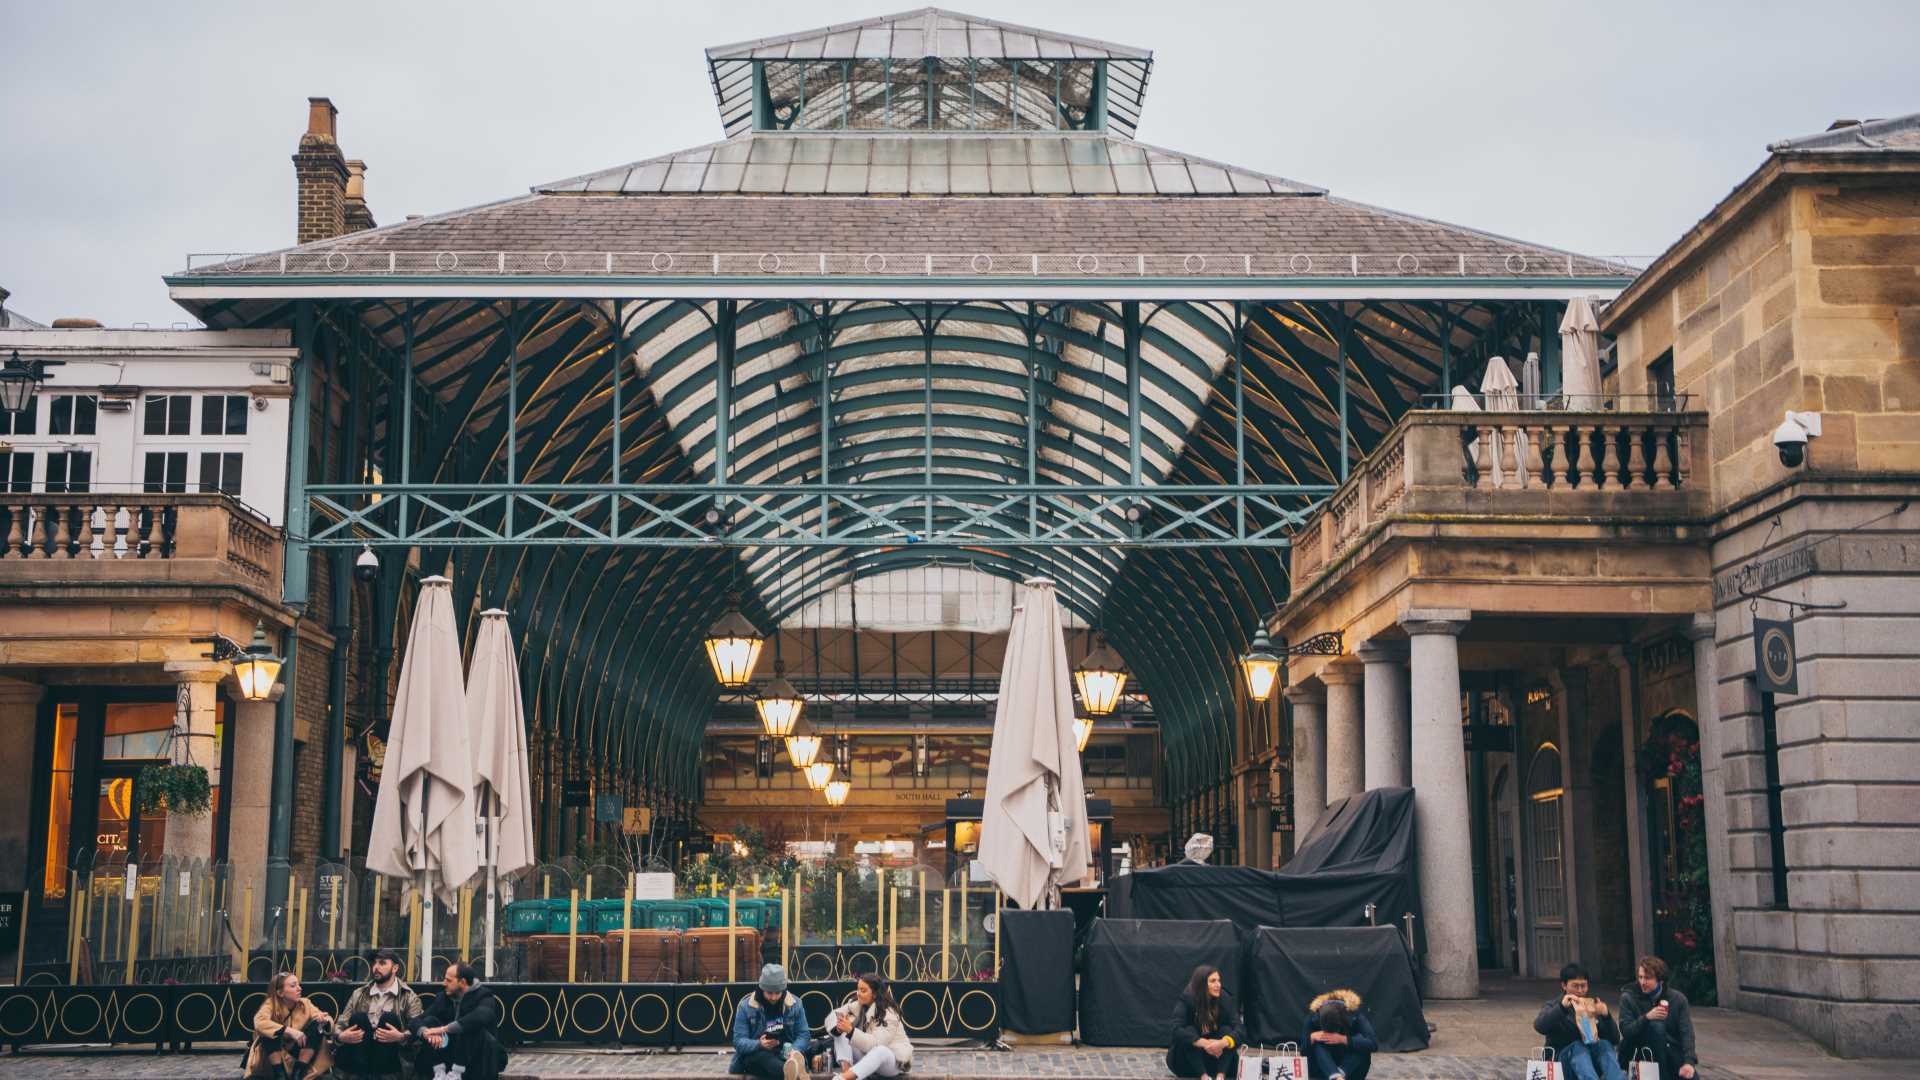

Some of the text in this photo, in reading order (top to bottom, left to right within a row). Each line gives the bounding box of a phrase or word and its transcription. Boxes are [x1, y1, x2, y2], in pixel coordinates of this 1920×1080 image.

[896, 791, 943, 800] SOUTH HALL
[556, 913, 583, 923] VyA
[602, 913, 625, 923] VyT
